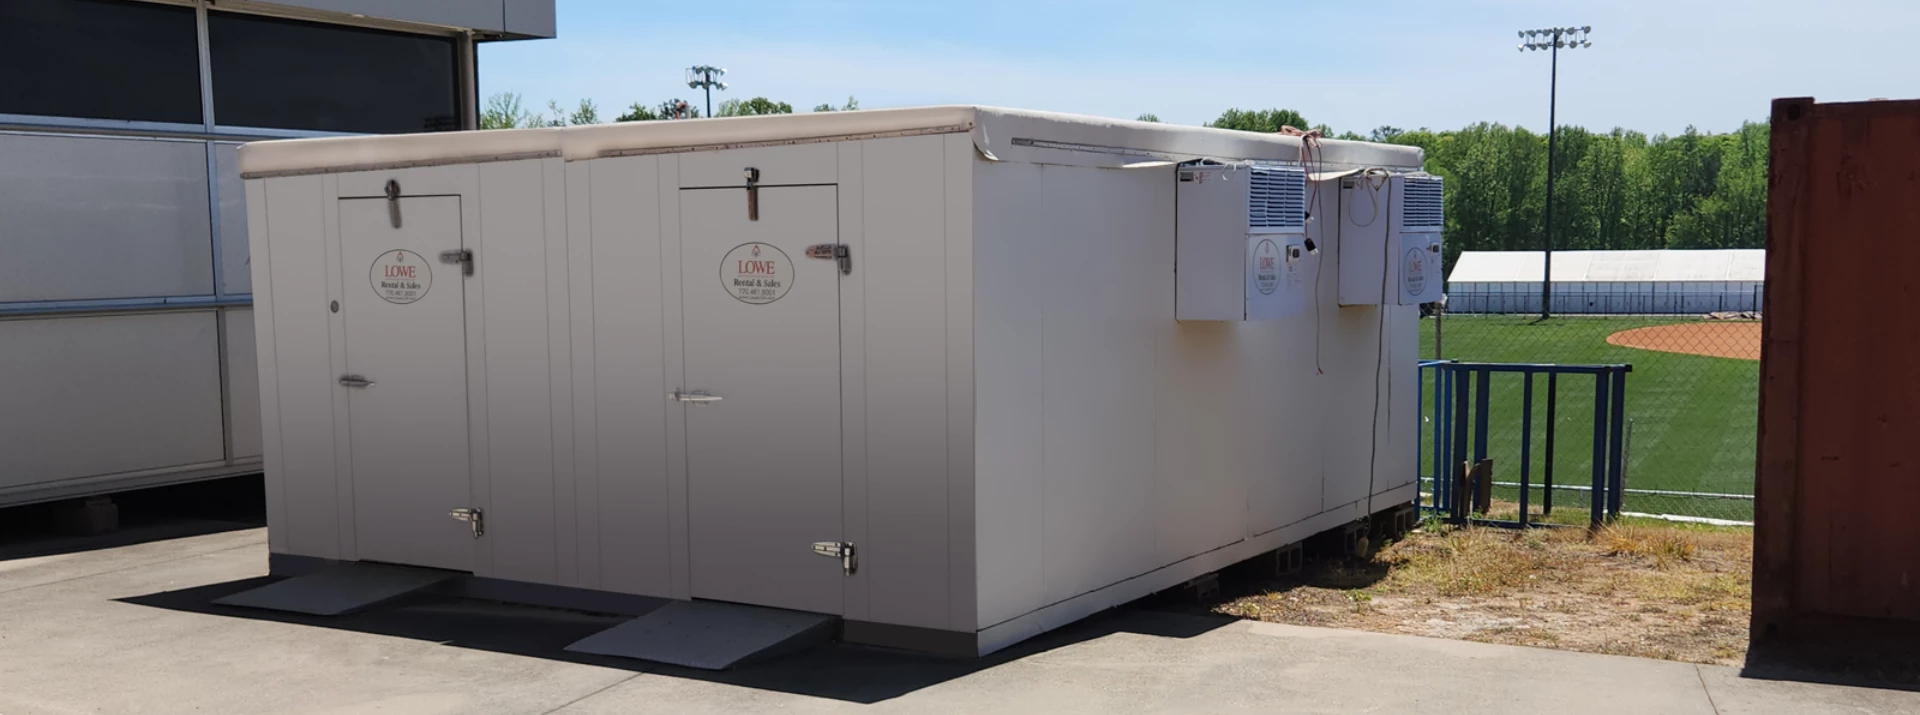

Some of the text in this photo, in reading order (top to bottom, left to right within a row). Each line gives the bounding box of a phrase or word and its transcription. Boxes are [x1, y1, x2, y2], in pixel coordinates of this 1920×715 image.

[385, 265, 416, 278] LOWE
[738, 260, 775, 274] LOWE
[381, 281, 398, 289] Rental
[733, 278, 755, 287] Rental
